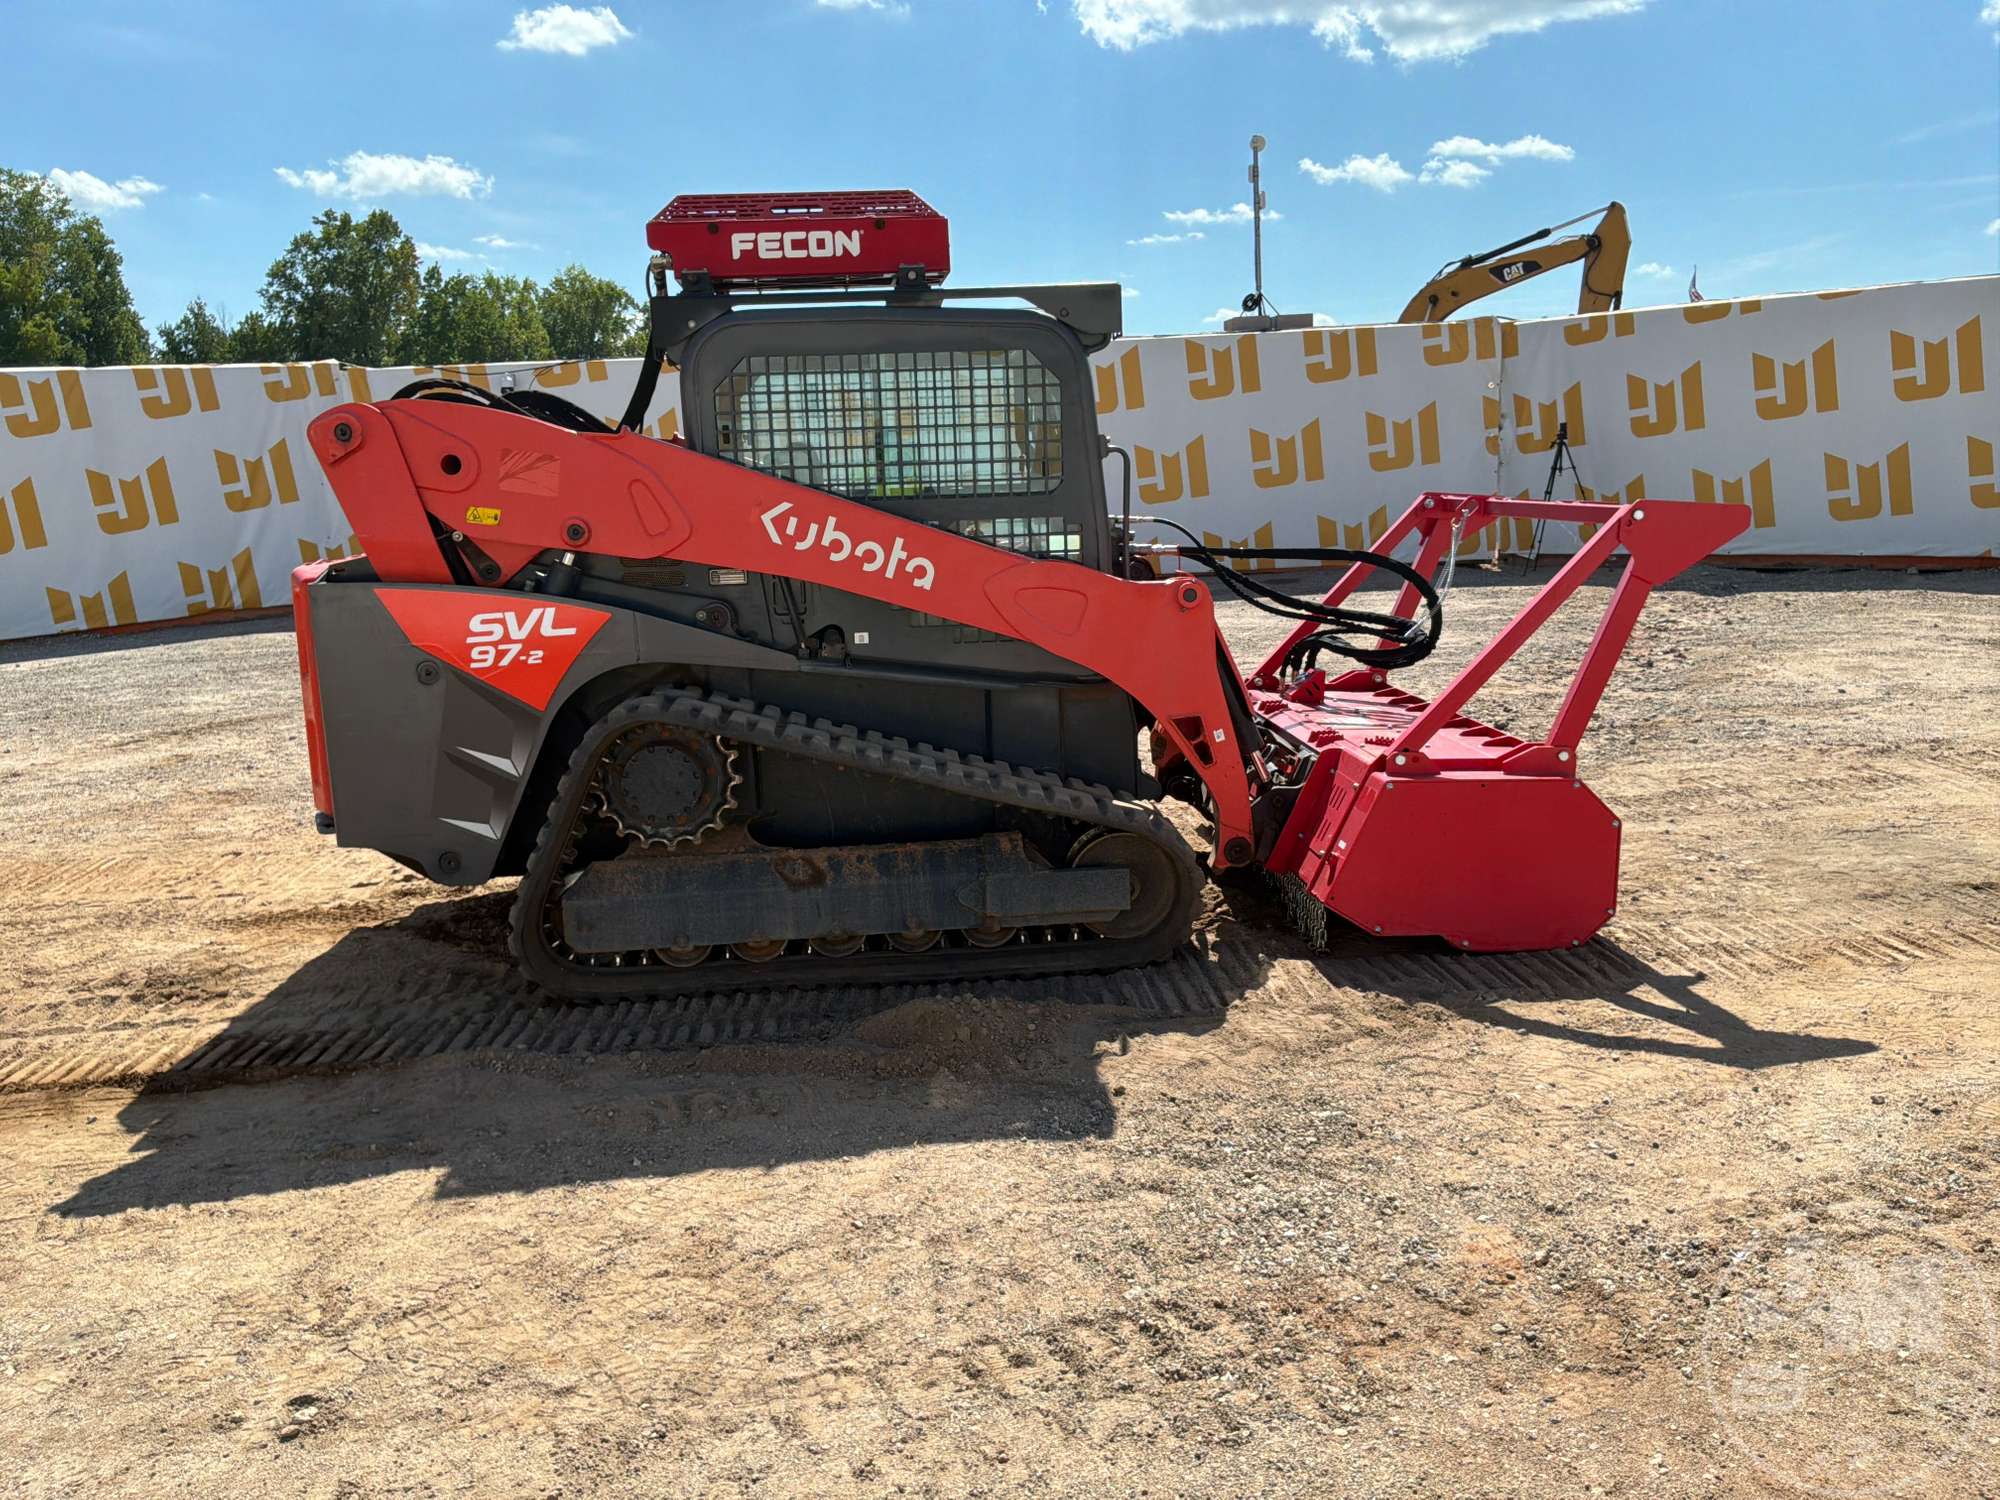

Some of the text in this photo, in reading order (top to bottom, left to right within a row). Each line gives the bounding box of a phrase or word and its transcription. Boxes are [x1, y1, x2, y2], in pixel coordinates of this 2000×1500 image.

[731, 229, 861, 260] FECON
[1503, 262, 1525, 281] CAT
[760, 501, 935, 591] Kubota
[466, 607, 577, 643] SVL
[470, 643, 544, 668] 97-2
